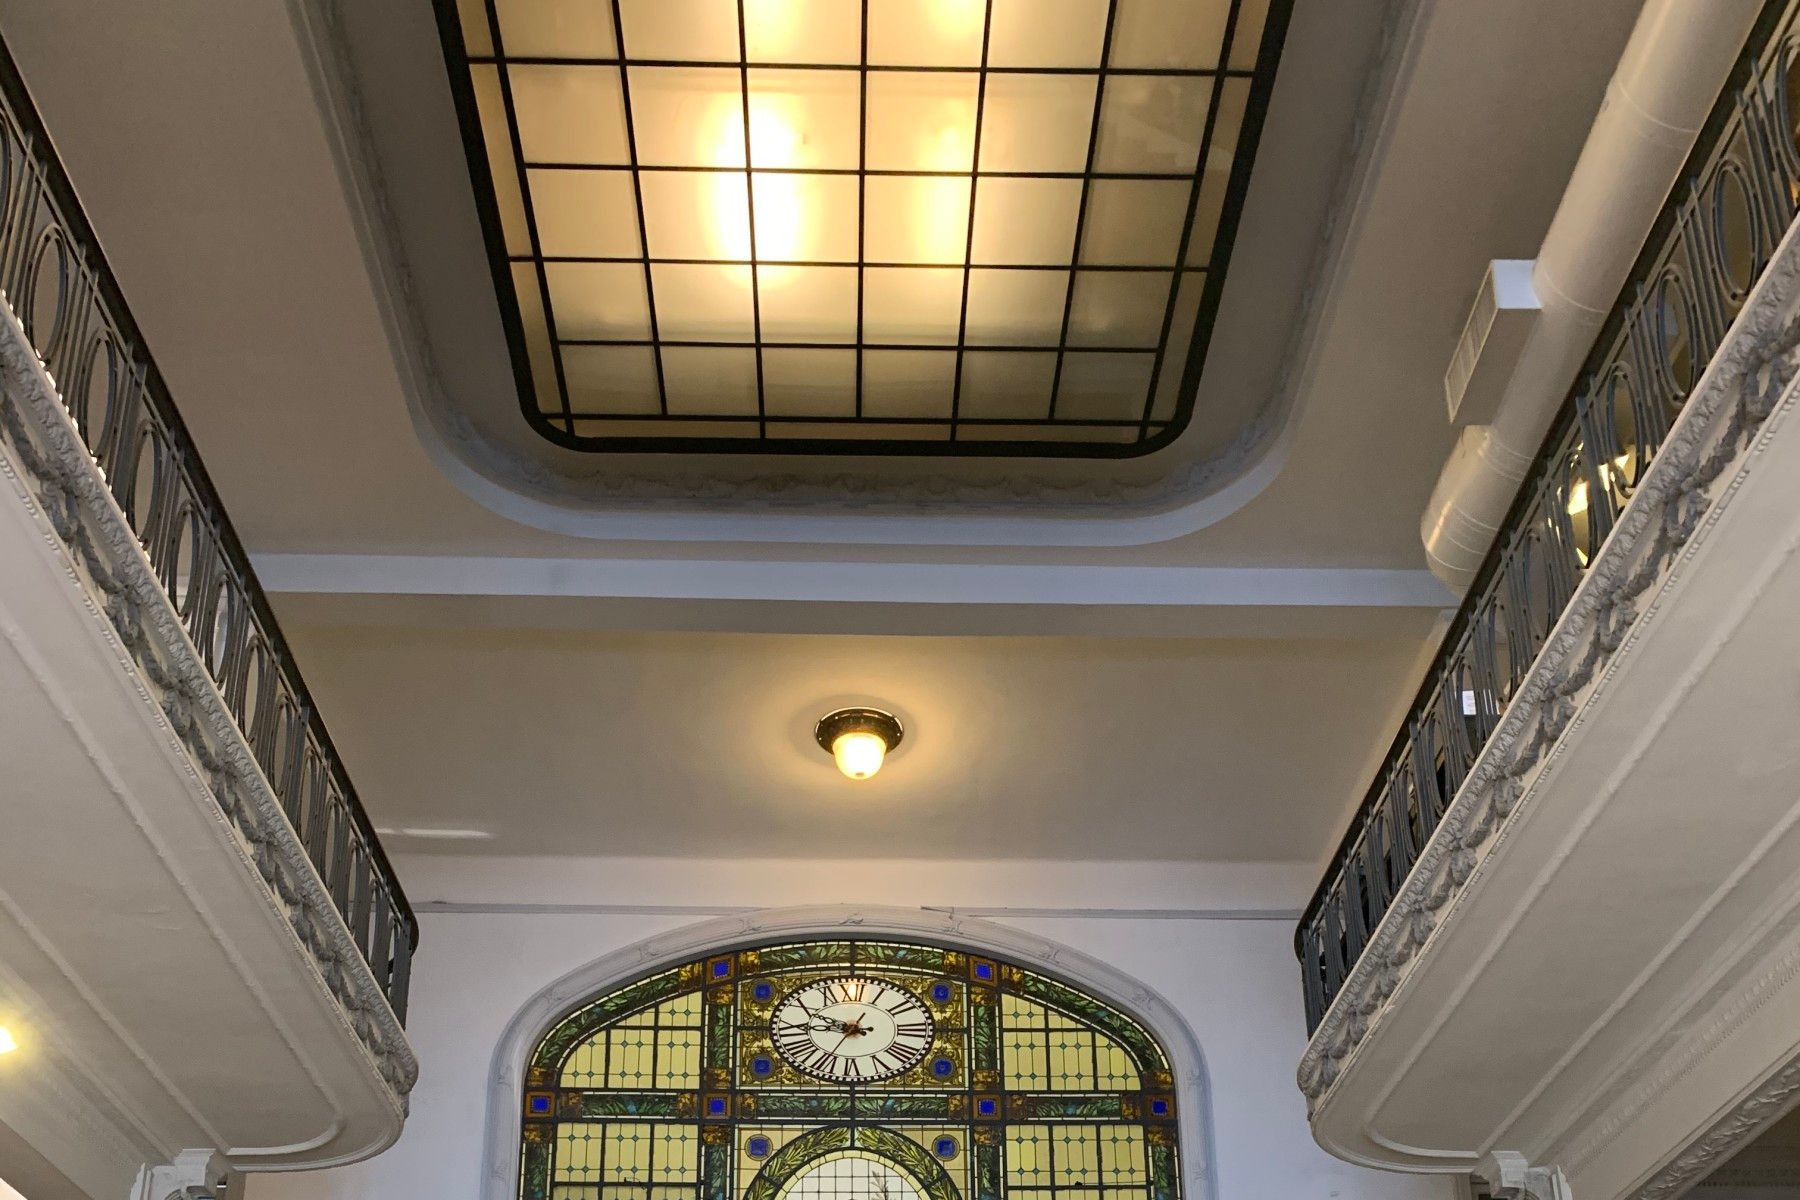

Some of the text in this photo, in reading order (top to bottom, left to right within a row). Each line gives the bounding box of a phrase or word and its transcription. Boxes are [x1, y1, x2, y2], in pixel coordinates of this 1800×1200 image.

[816, 985, 840, 1008] XI
[839, 983, 865, 1002] XII
[884, 997, 920, 1019] II
[896, 1020, 929, 1039] III
[842, 1057, 863, 1077] VI
